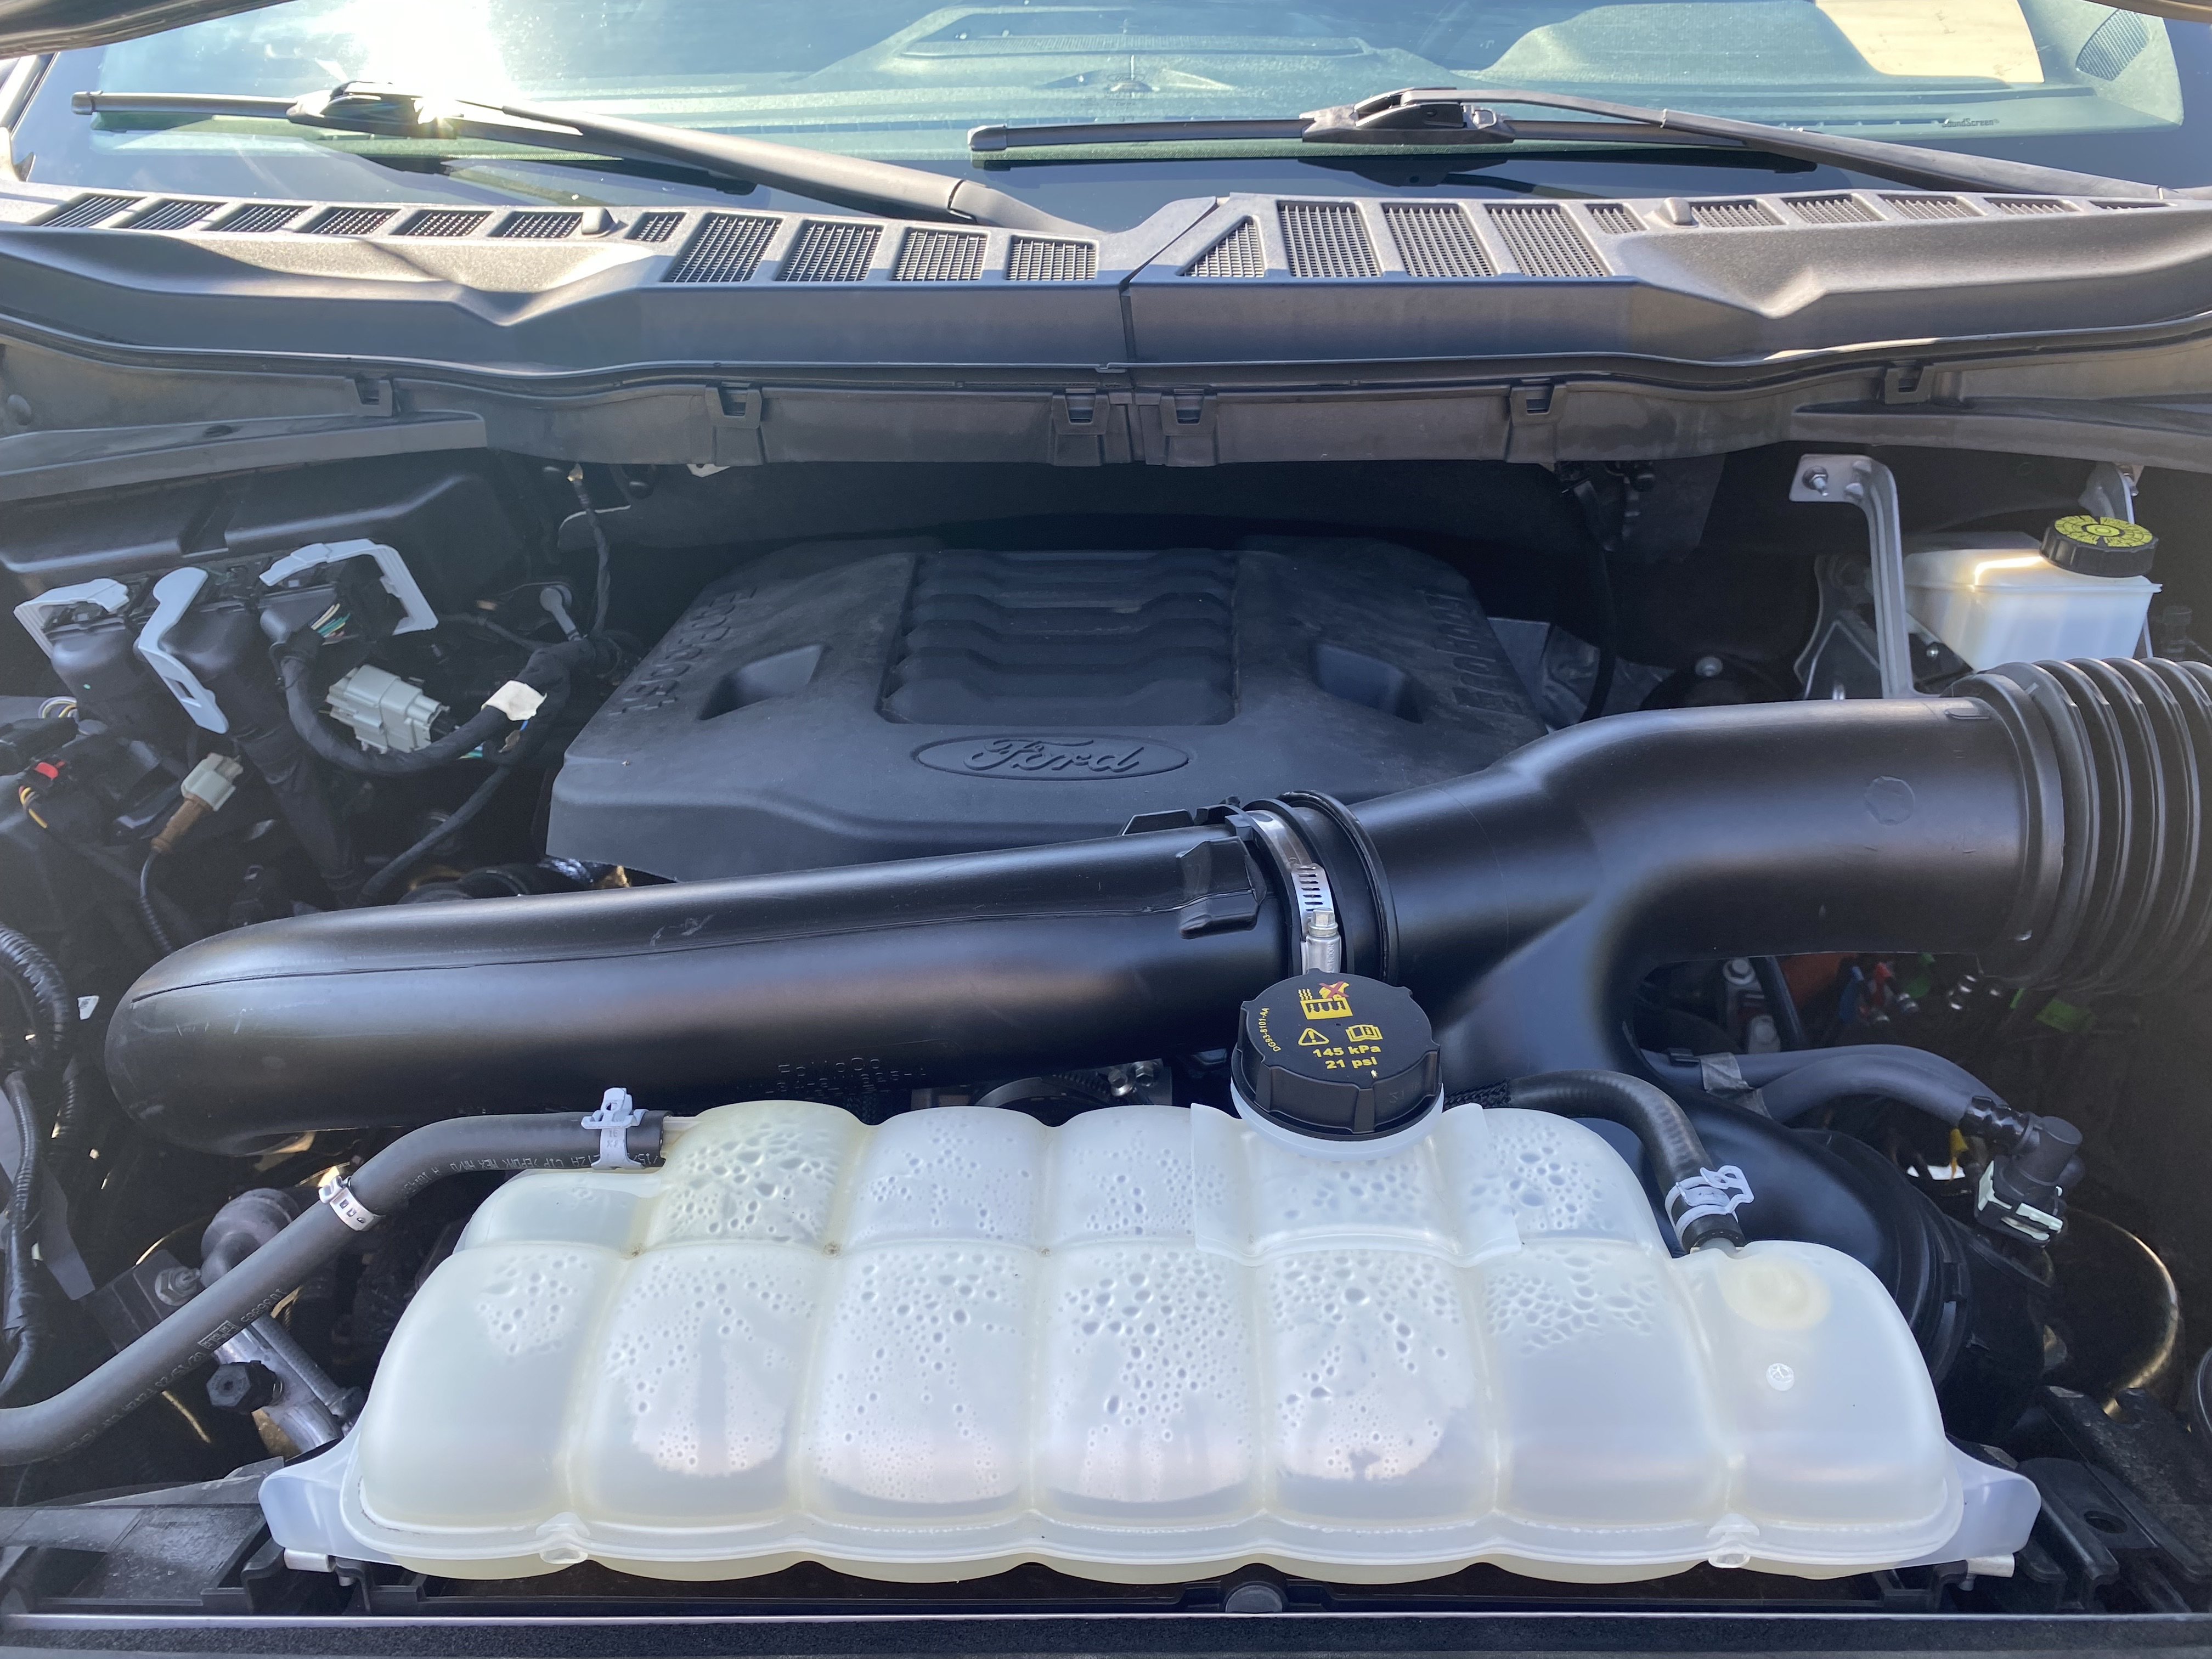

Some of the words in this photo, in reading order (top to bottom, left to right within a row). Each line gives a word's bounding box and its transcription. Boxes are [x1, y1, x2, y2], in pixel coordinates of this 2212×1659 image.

[963, 737, 1148, 774] Ford
[1258, 1007, 1281, 1052] DG93-8101-AA
[1312, 1047, 1344, 1058] 145
[1348, 1045, 1381, 1055] kPa
[1325, 1059, 1345, 1069] 21
[1352, 1057, 1378, 1069] psi
